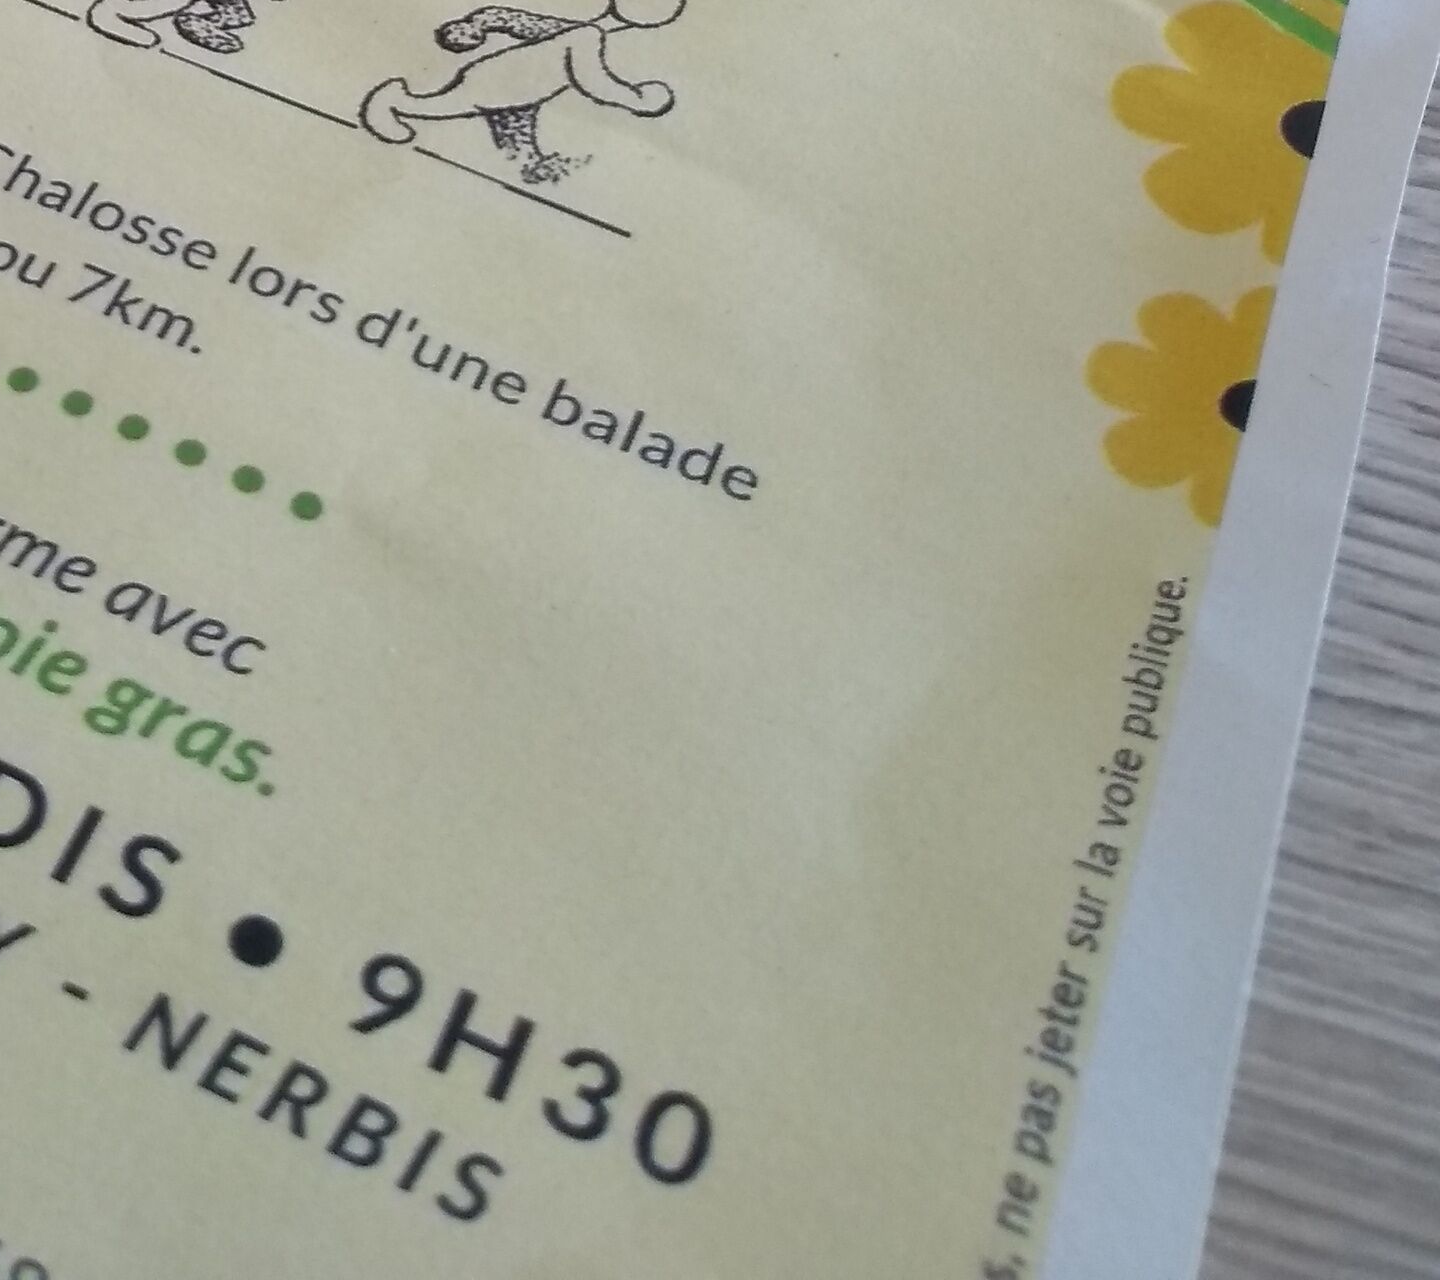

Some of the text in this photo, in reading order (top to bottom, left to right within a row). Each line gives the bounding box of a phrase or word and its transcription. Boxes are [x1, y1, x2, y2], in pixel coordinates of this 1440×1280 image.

[67, 263, 203, 356] 7km.
[228, 247, 345, 327] lors
[356, 307, 529, 407] d'une
[541, 378, 761, 504] balade
[103, 579, 268, 676] avec
[1120, 575, 1190, 741] publique.
[83, 677, 277, 798] gras.
[1097, 747, 1147, 828] voie
[1072, 840, 1122, 878] la
[1066, 885, 1109, 954] sur
[1024, 959, 1090, 1080] jeter
[122, 991, 506, 1222] NERBIS
[348, 951, 715, 1187] 9H30
[1014, 1078, 1063, 1169] pas
[996, 1170, 1041, 1238] ne
